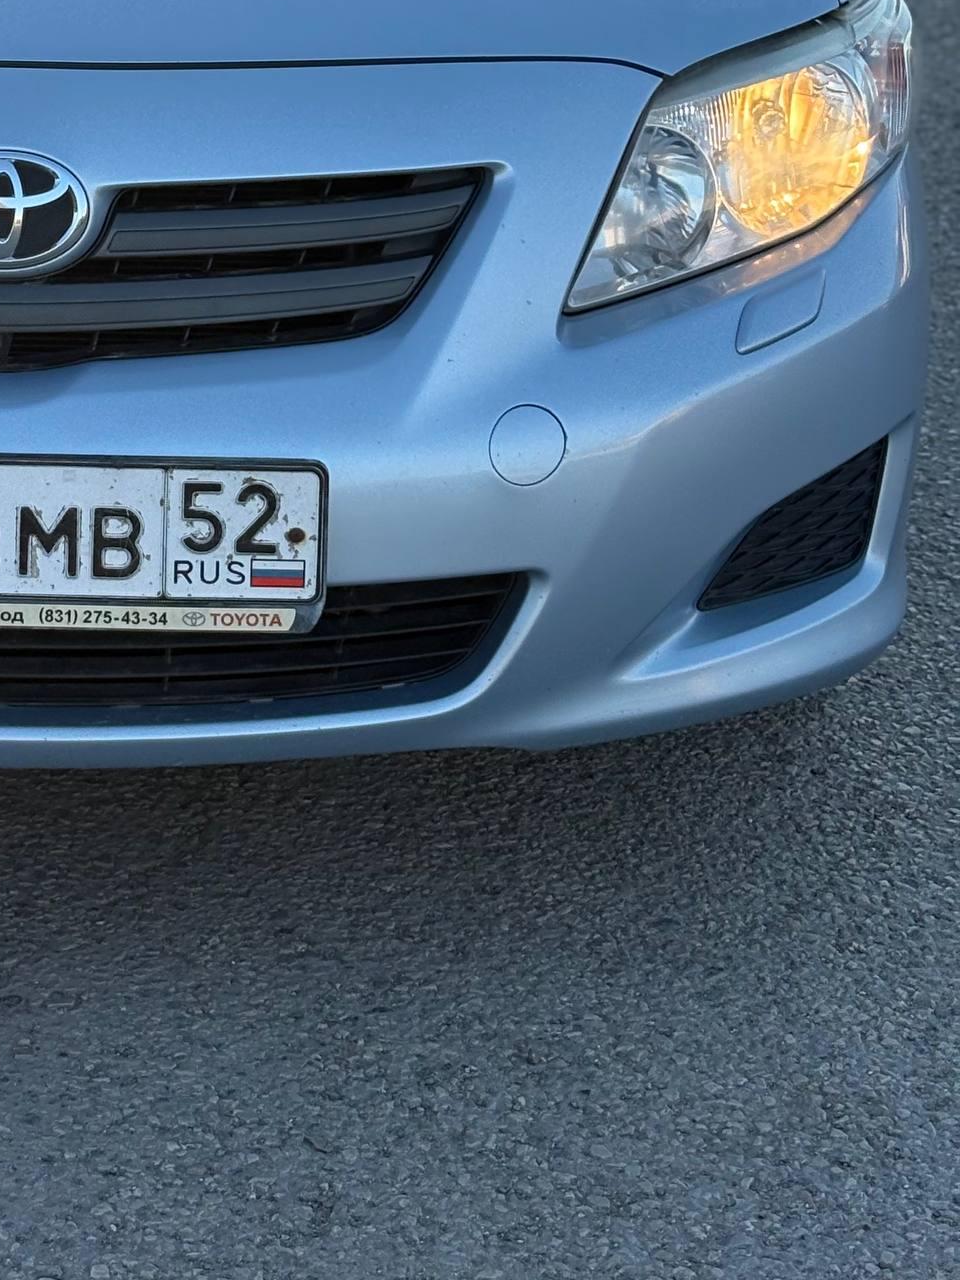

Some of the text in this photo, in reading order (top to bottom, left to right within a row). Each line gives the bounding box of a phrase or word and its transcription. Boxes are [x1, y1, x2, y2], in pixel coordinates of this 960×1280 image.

[181, 481, 278, 554] 52
[174, 560, 246, 584] RUS
[39, 606, 78, 625] (831)
[82, 609, 169, 626] 275-43-34
[210, 612, 283, 627] TOYOTA
